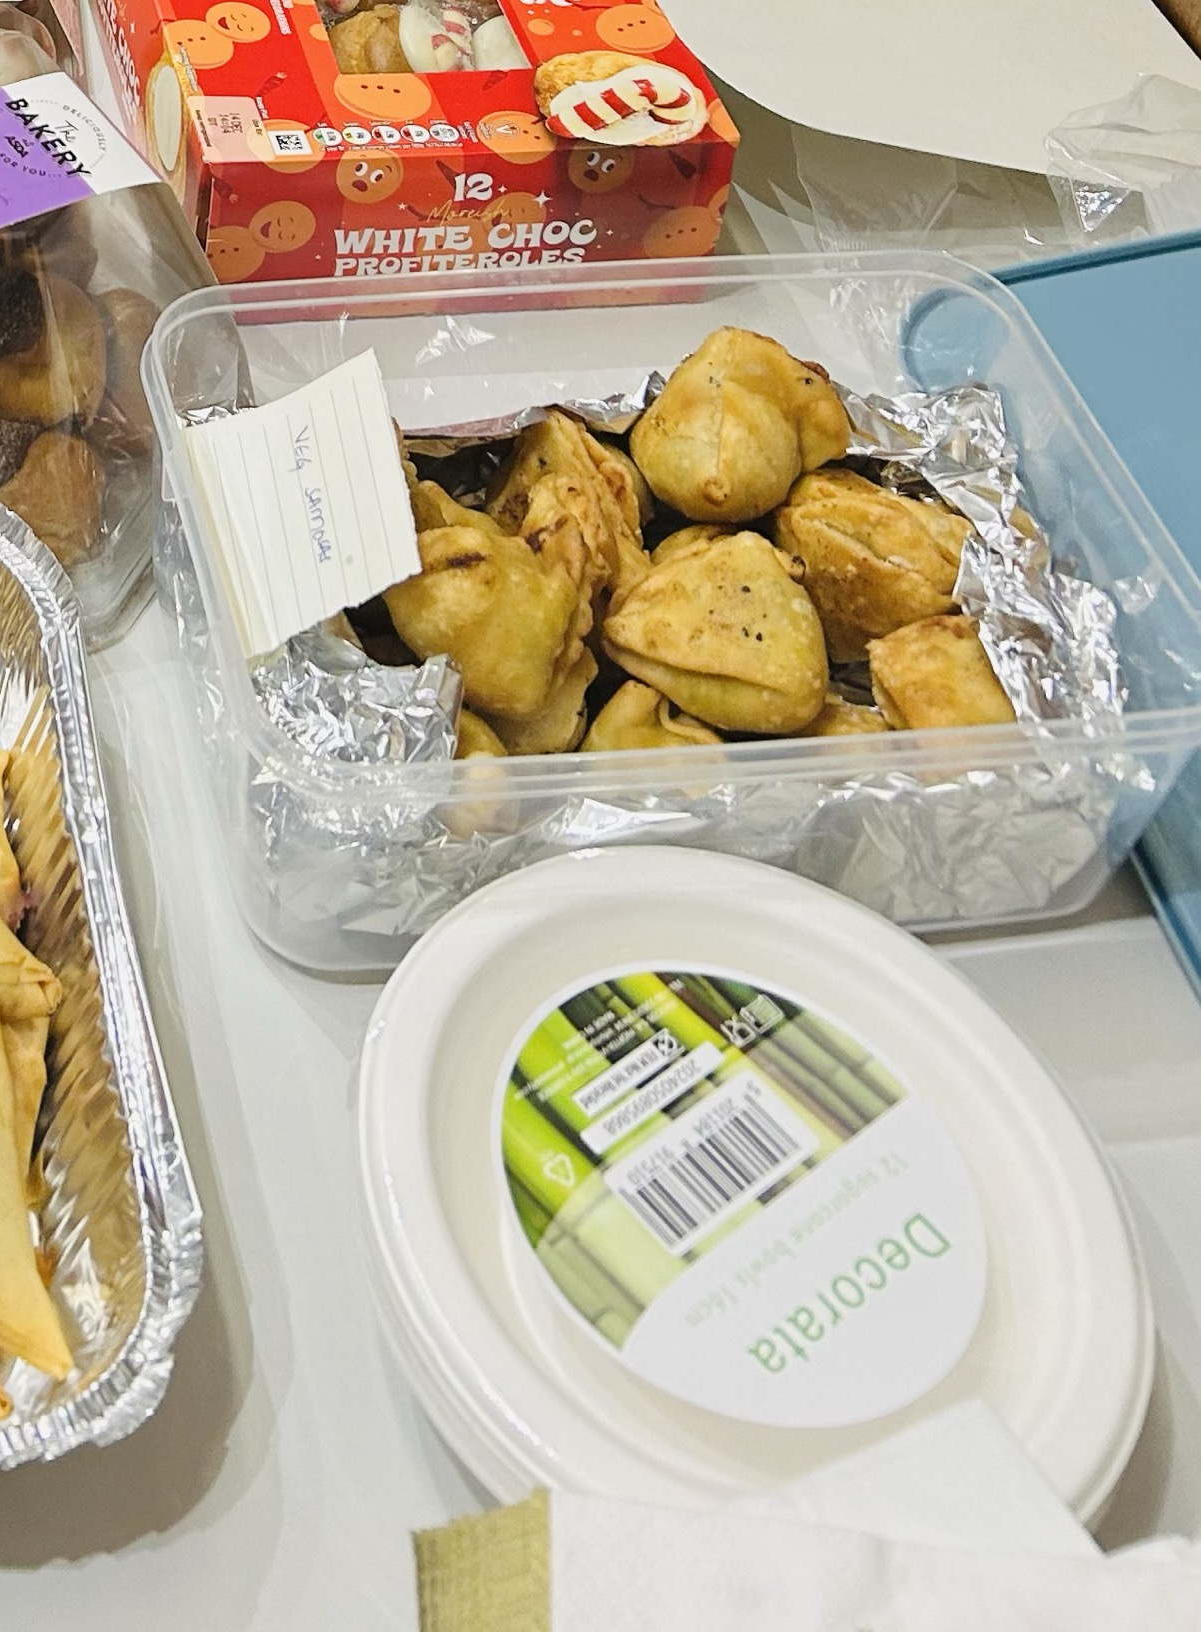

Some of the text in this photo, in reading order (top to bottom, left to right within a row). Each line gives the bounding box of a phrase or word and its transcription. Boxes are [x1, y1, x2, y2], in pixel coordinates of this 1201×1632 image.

[5, 98, 91, 176] BAKERY
[55, 120, 79, 142] The
[62, 105, 107, 152] DELICIOUSLY
[231, 121, 243, 134] DEC
[5, 136, 29, 158] ASDA
[0, 153, 18, 168] FOR
[23, 166, 46, 176] YOU
[453, 172, 494, 202] 12
[333, 218, 597, 255] WHITE CHOC
[333, 248, 587, 277] PROFITEROLES
[880, 1152, 908, 1177] 12
[791, 1171, 878, 1241] sugarcane
[736, 1239, 798, 1287] bowls
[749, 1212, 951, 1374] Decorata
